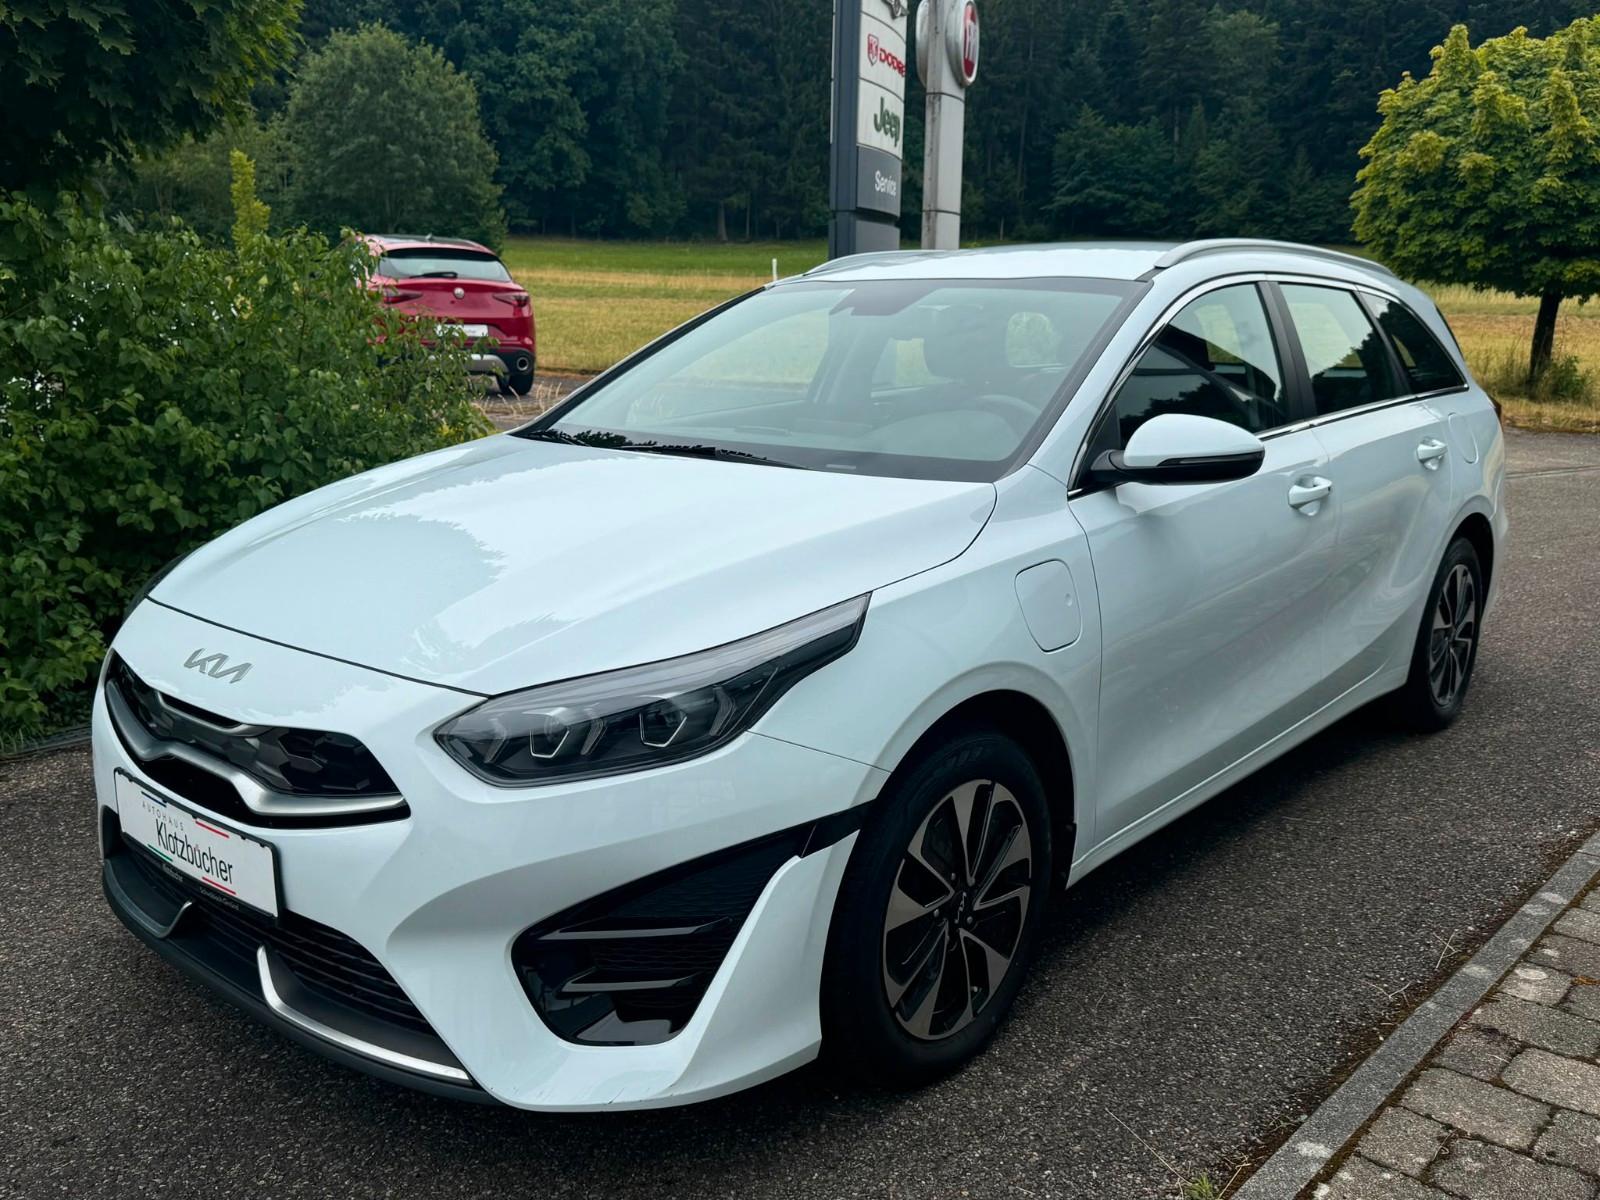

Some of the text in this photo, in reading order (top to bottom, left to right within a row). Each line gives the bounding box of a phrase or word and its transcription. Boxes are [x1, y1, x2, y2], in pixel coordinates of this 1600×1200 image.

[873, 96, 901, 148] Jeep
[874, 169, 897, 197] Service
[183, 647, 253, 685] KIA
[142, 800, 184, 831] AUTOHAUS
[155, 818, 233, 885] Klotzbücher
